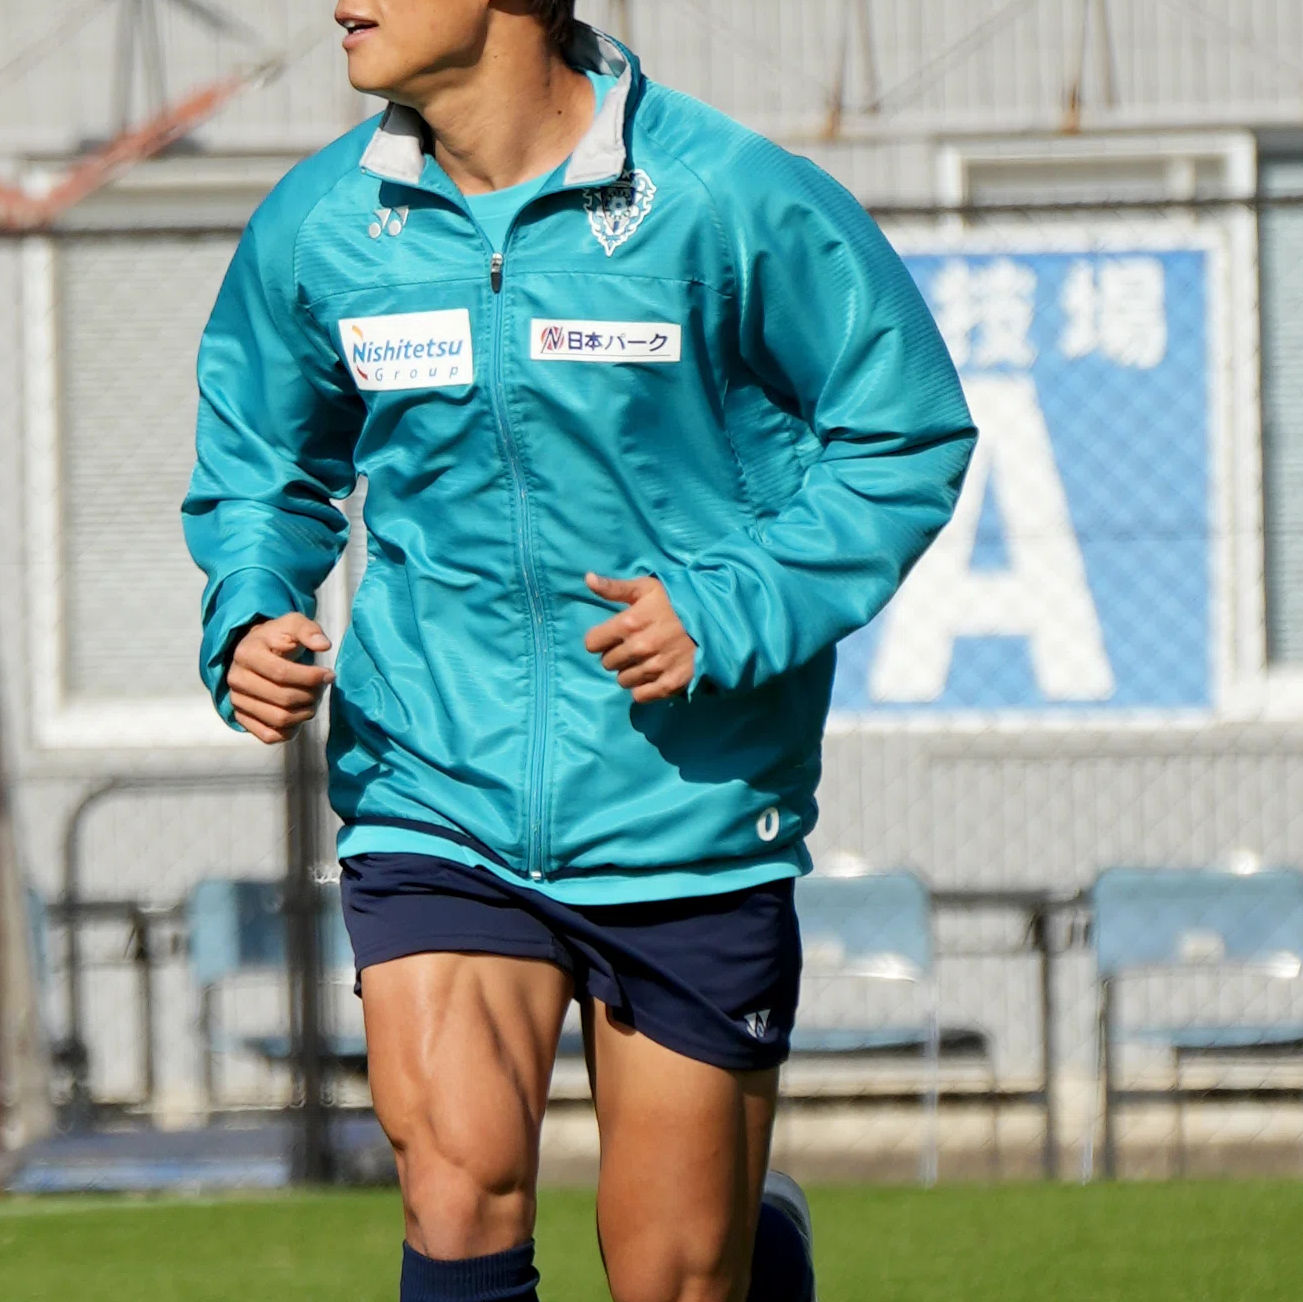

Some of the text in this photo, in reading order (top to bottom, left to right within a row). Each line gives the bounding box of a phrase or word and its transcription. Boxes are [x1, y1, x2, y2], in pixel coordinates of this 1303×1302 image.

[353, 338, 463, 364] Nishitetsu
[568, 329, 668, 353] 日本パーク
[374, 366, 459, 382] Group
[870, 374, 1116, 703] A
